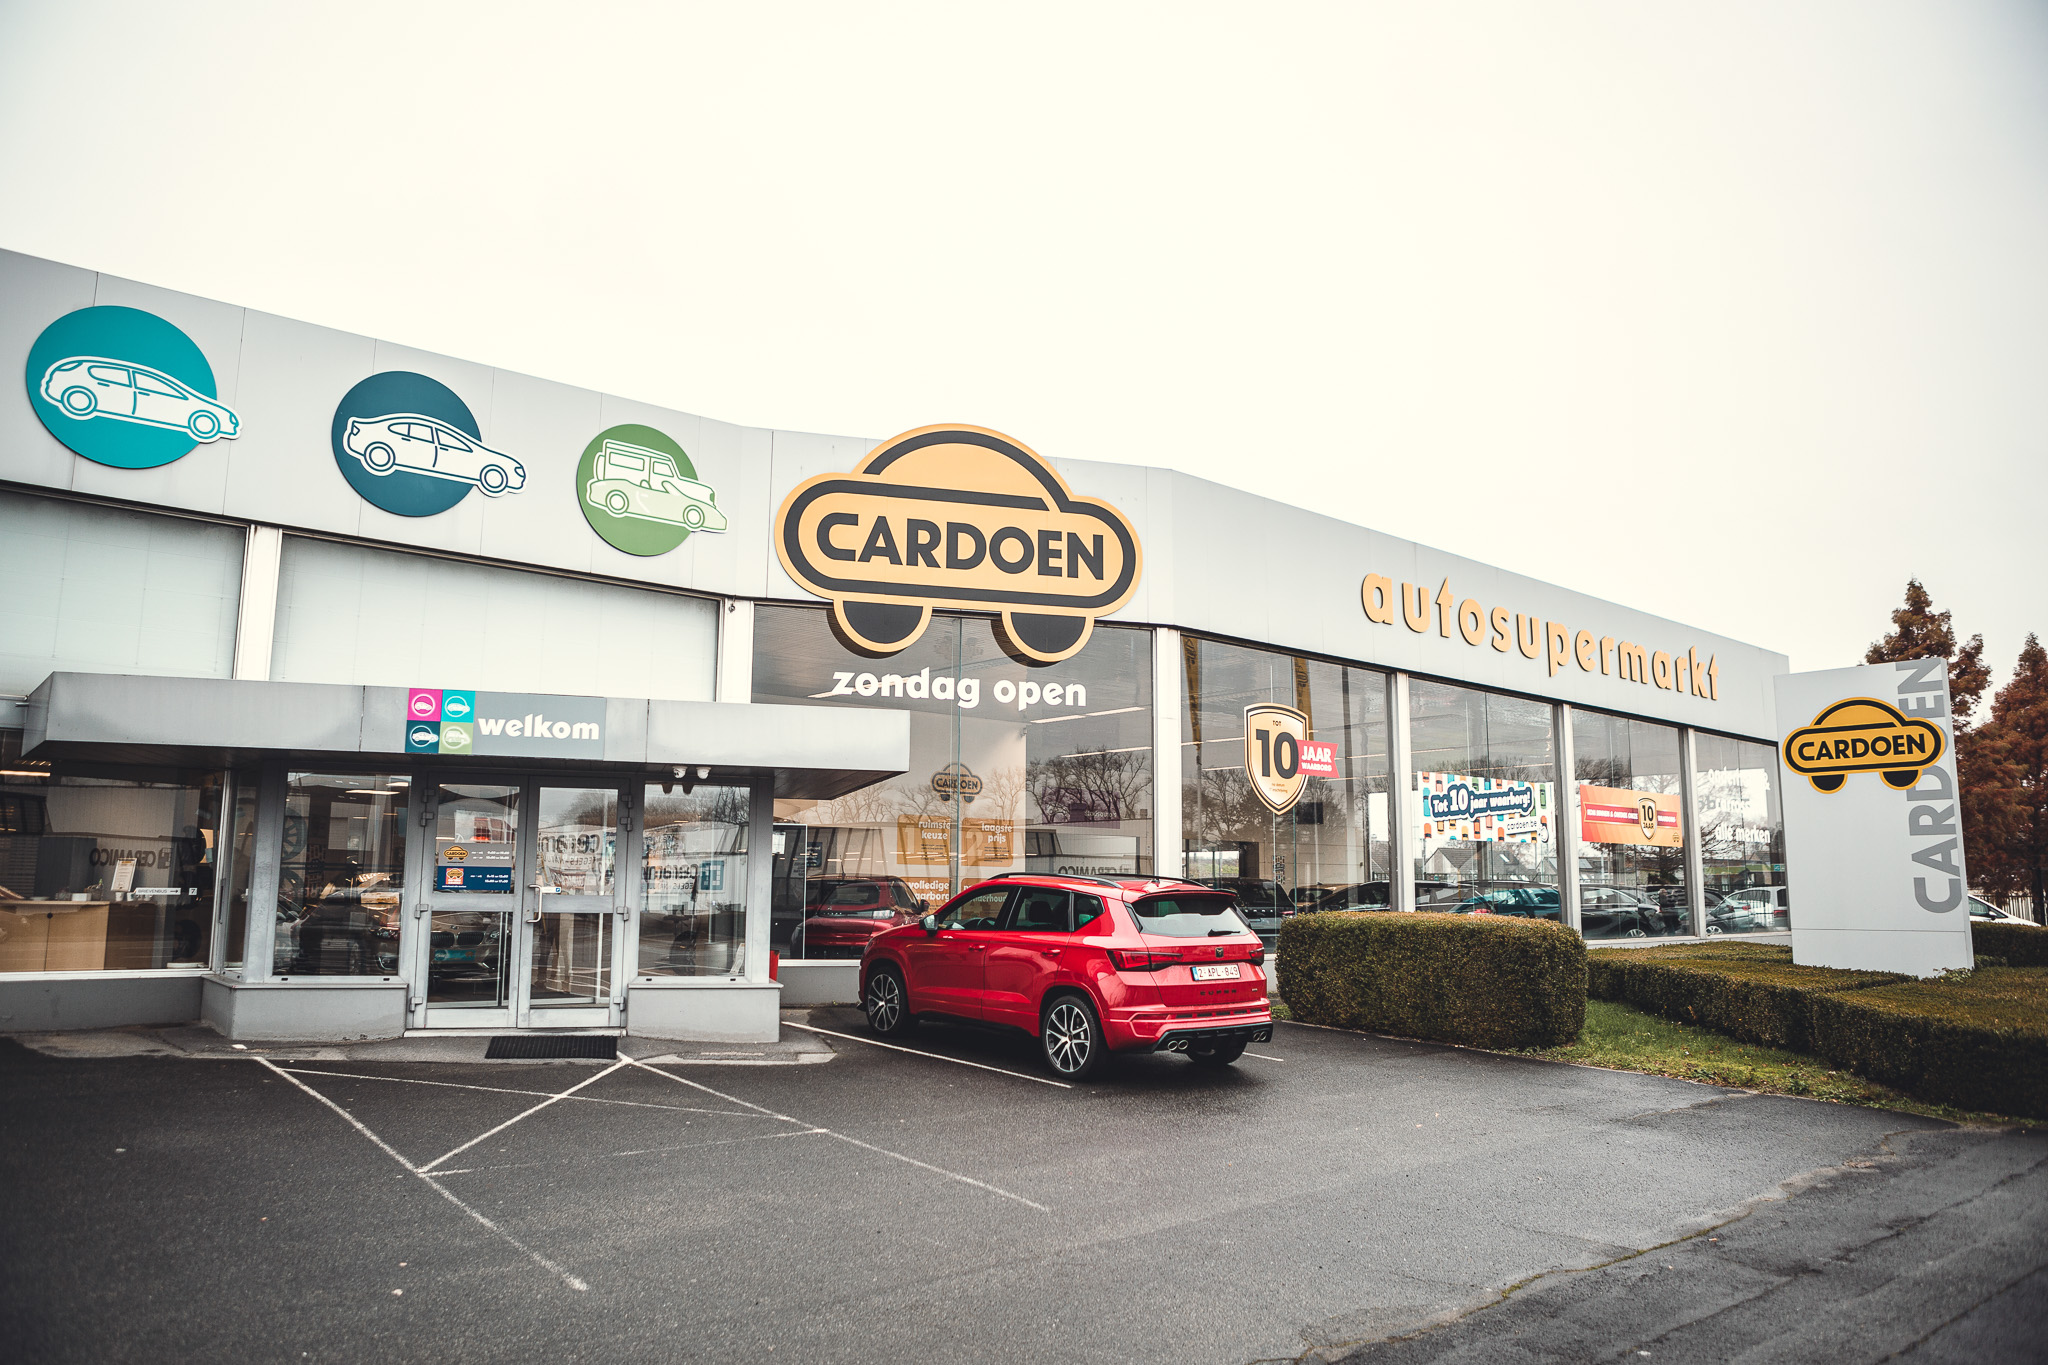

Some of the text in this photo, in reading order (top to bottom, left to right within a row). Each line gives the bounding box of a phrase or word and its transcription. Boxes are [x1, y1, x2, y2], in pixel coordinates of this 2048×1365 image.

[816, 512, 1104, 581] CARDOEN
[1361, 572, 1719, 701] autosupermarkt
[831, 667, 1087, 711] zondag open
[478, 713, 600, 740] welkom
[1256, 728, 1299, 780] 10
[1301, 745, 1332, 764] JAAR
[1798, 733, 1926, 762] CARDOEN
[1301, 762, 1333, 772] WAARBORG
[1895, 657, 1961, 914] CARDEN
[1433, 788, 1531, 814] Tot 10 jaar waarborg!
[1642, 804, 1654, 822] 10
[921, 830, 948, 840] keuze
[981, 823, 1013, 833] laagste
[1715, 822, 1771, 843] alle merken
[987, 834, 1006, 844] prijs
[908, 880, 949, 892] volledige
[915, 893, 949, 902] aarborg
